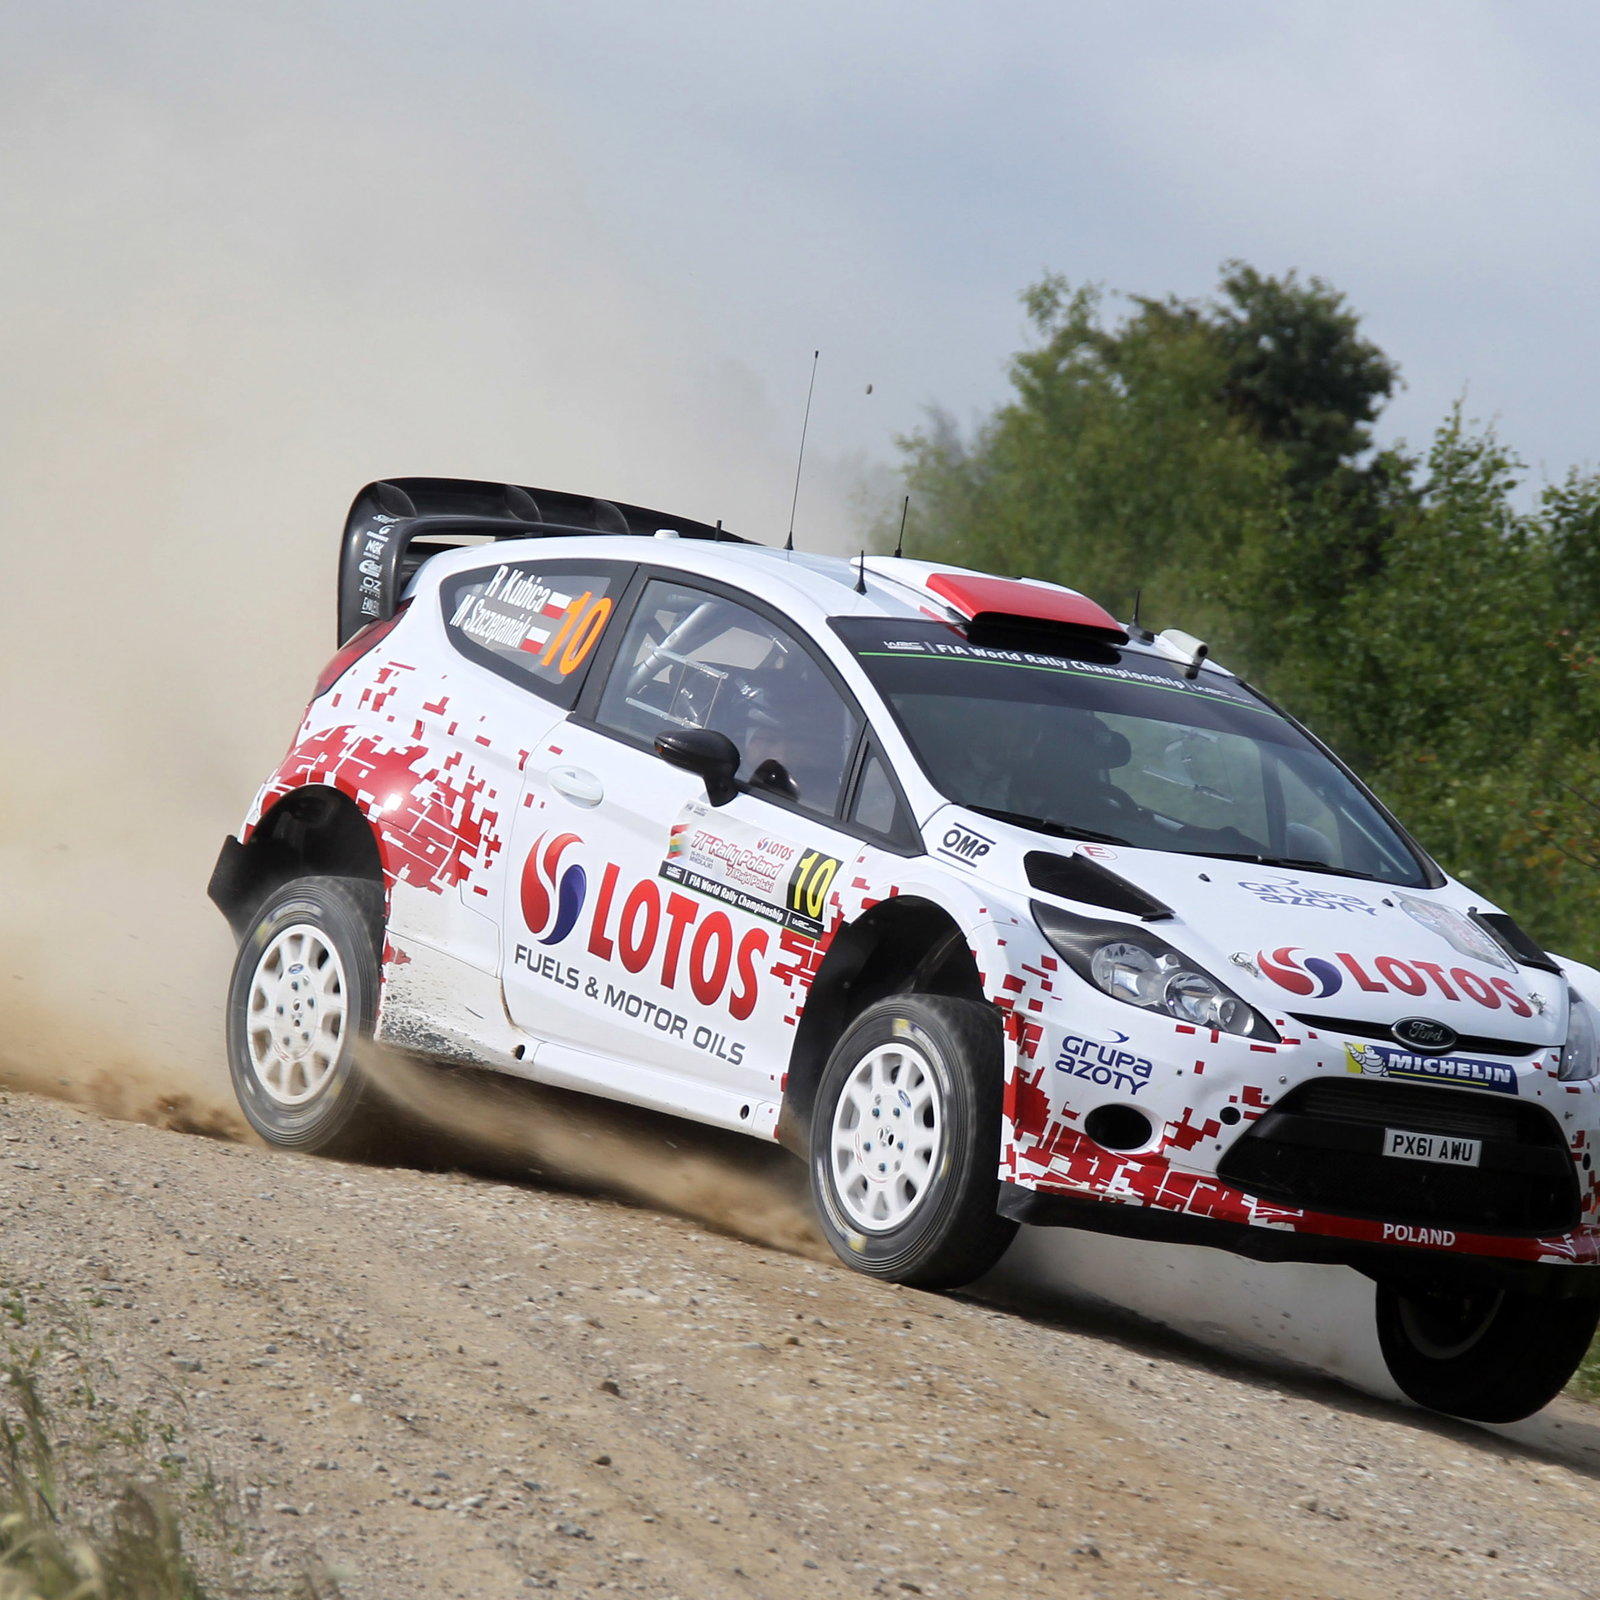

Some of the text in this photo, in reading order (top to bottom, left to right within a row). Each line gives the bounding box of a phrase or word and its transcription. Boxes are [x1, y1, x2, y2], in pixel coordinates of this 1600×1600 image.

[363, 577, 382, 592] OZ
[484, 565, 551, 612] R Kubica
[449, 594, 532, 648] M Szczepaniak
[541, 591, 612, 675] 10
[935, 643, 969, 655] FIA
[968, 646, 1022, 662] World
[1024, 653, 1068, 670] Rally
[1070, 659, 1186, 689] Championship
[709, 838, 741, 868] Rally
[737, 849, 784, 880] Poland
[766, 840, 794, 861] LOTOS
[942, 829, 991, 860] OMP
[1083, 845, 1111, 858] E
[688, 874, 702, 888] FIA
[701, 879, 722, 896] World
[720, 886, 739, 905] Rally
[737, 893, 784, 922] Championship
[798, 851, 837, 918] 10
[587, 861, 770, 1021] LOTOS
[514, 943, 747, 1067] FUELS & MOTOR OILS
[1333, 952, 1533, 1019] LOTOS
[1408, 1021, 1444, 1042] Ford
[1387, 1053, 1511, 1083] MICHELIN
[1391, 1134, 1473, 1162] PX61 AWU
[1383, 1223, 1456, 1247] POLAND
